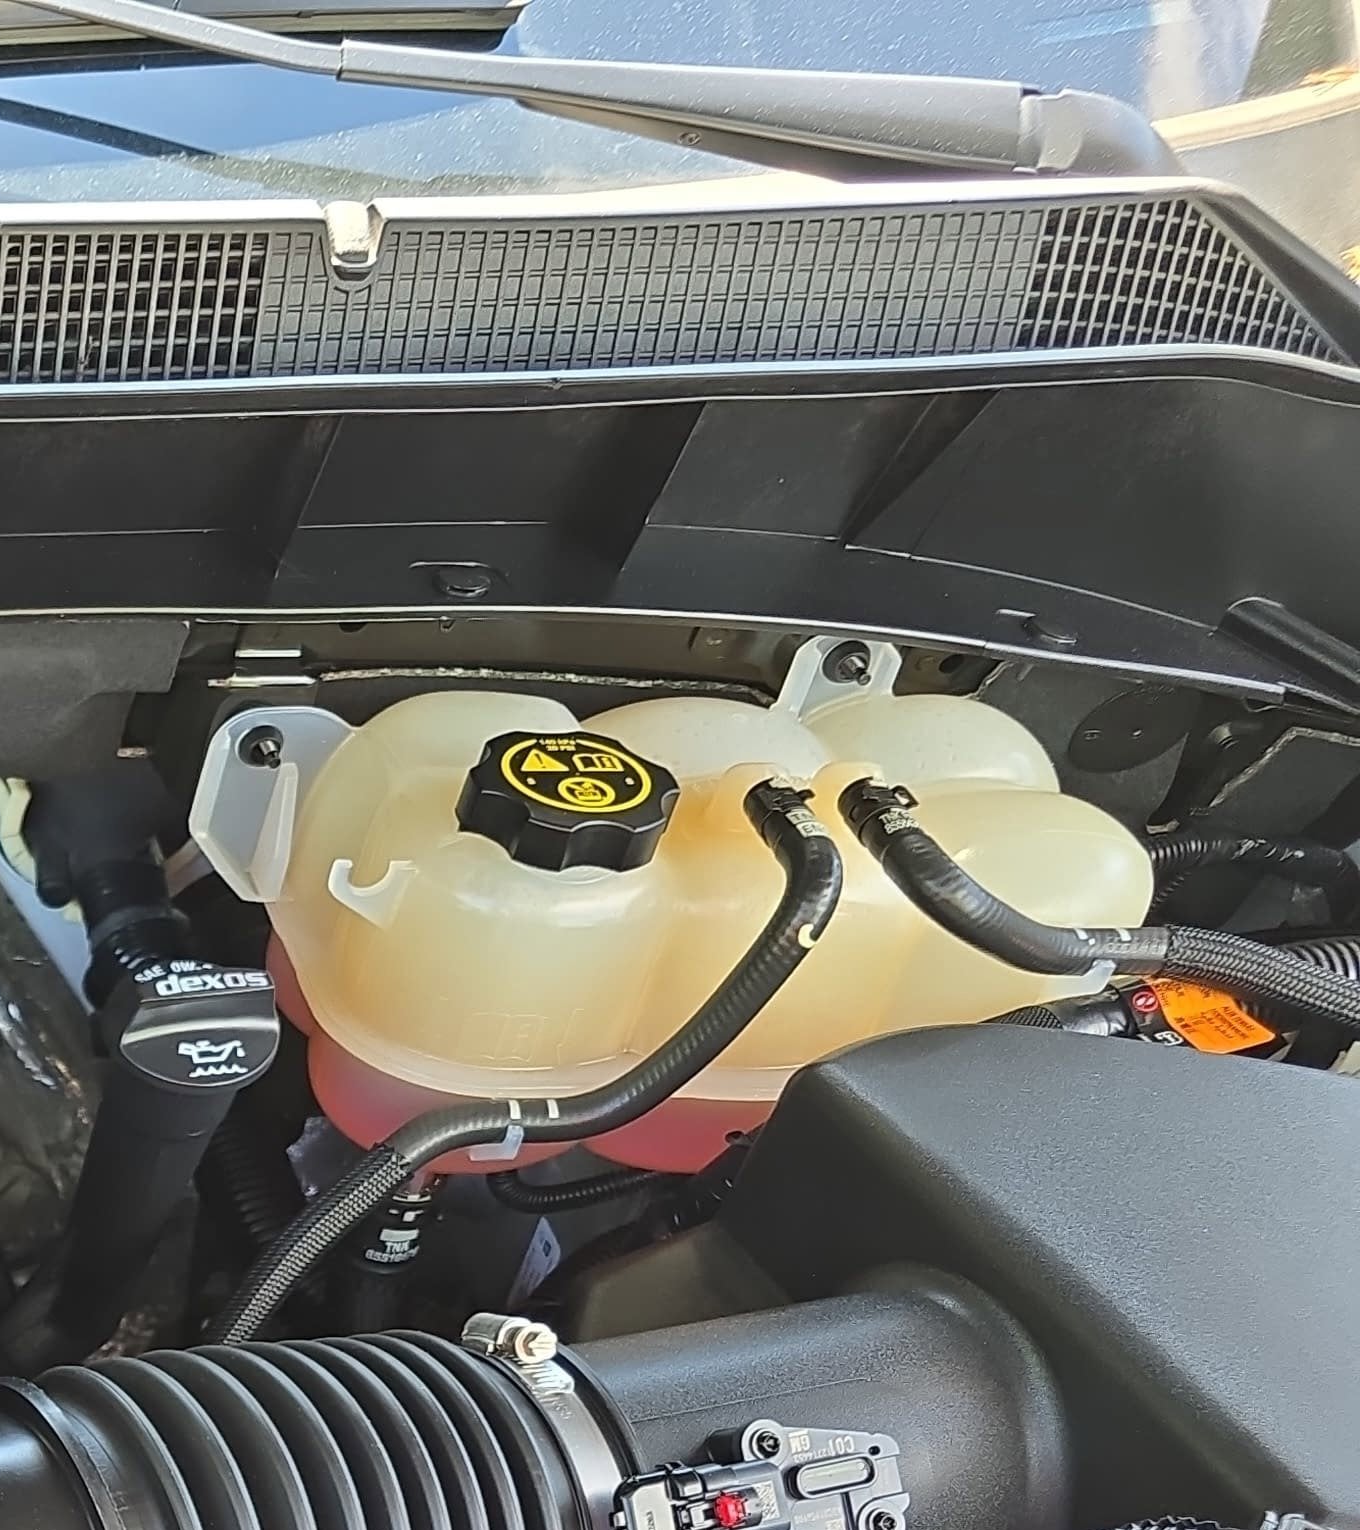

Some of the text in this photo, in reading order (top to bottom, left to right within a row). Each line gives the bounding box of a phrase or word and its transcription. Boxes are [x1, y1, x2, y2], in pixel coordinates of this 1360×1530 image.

[133, 965, 167, 984] SAE
[154, 973, 270, 997] dexos
[788, 1431, 810, 1454] GM
